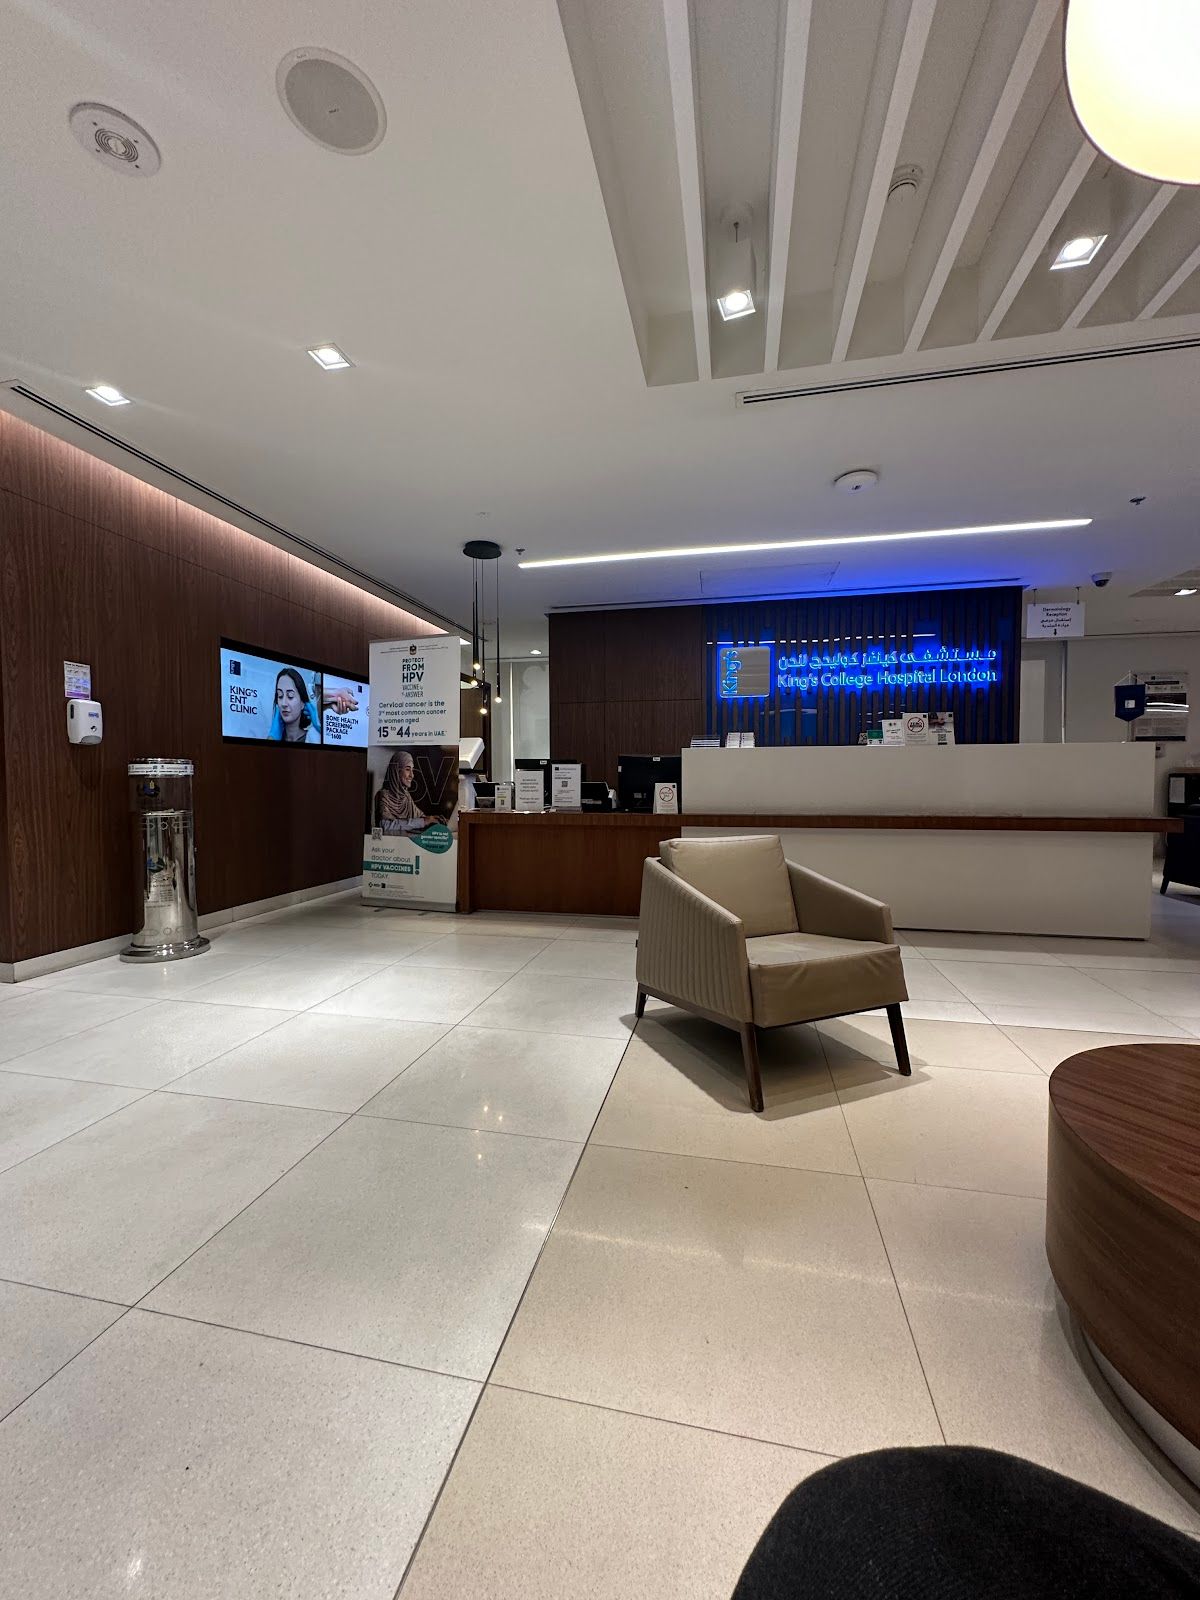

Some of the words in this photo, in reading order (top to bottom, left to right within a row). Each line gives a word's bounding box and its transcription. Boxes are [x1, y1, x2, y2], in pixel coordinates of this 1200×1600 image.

[900, 646, 997, 663] مستشفى
[402, 663, 424, 672] FROM
[778, 654, 808, 670] لندن
[402, 672, 424, 683] HPV
[722, 650, 742, 695] King's
[778, 673, 818, 690] King's
[821, 672, 873, 688] College
[878, 669, 936, 687] Hospital
[940, 668, 998, 683] London
[230, 686, 258, 697] KING'S
[230, 695, 248, 704] ENT
[230, 704, 258, 715] CLINIC
[326, 720, 353, 730] SCREENING
[340, 716, 359, 725] HEALTH
[377, 726, 389, 738] 15
[396, 726, 411, 738] 44
